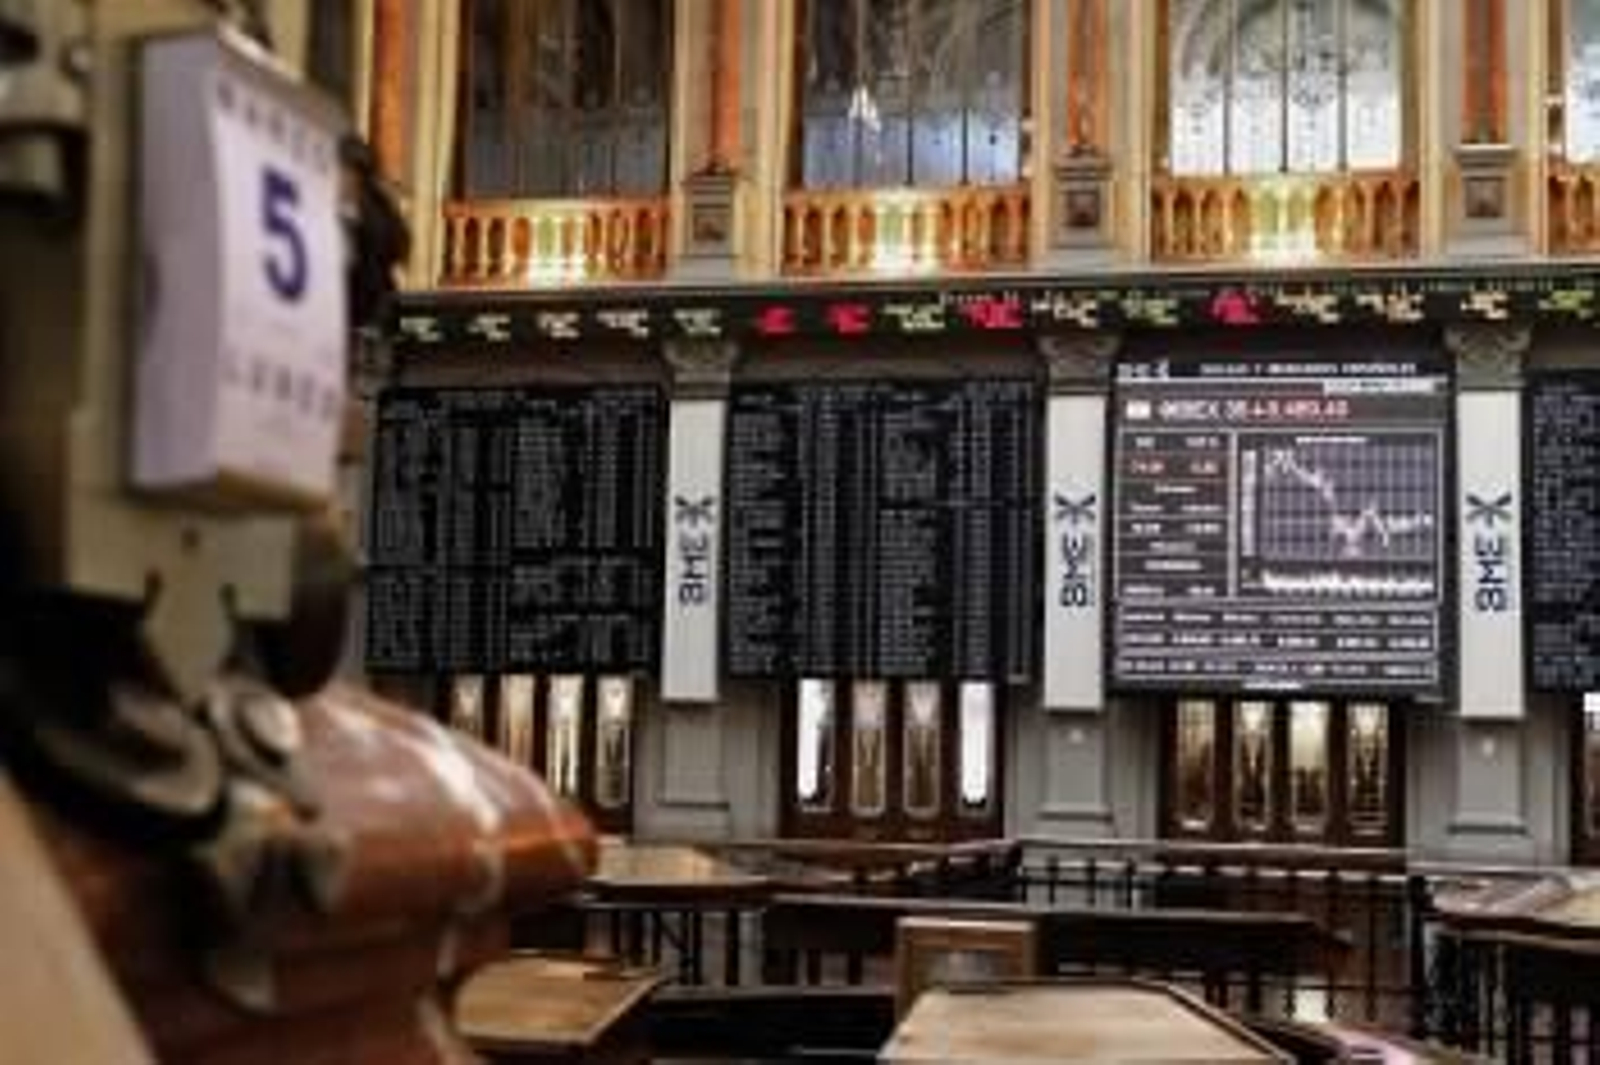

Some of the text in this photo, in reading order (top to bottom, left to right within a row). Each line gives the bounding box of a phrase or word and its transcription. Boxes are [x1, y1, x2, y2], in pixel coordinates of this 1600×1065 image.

[263, 167, 308, 302] 5
[679, 533, 708, 606] BME
[1060, 533, 1089, 608] BME
[1474, 533, 1508, 612] BME
